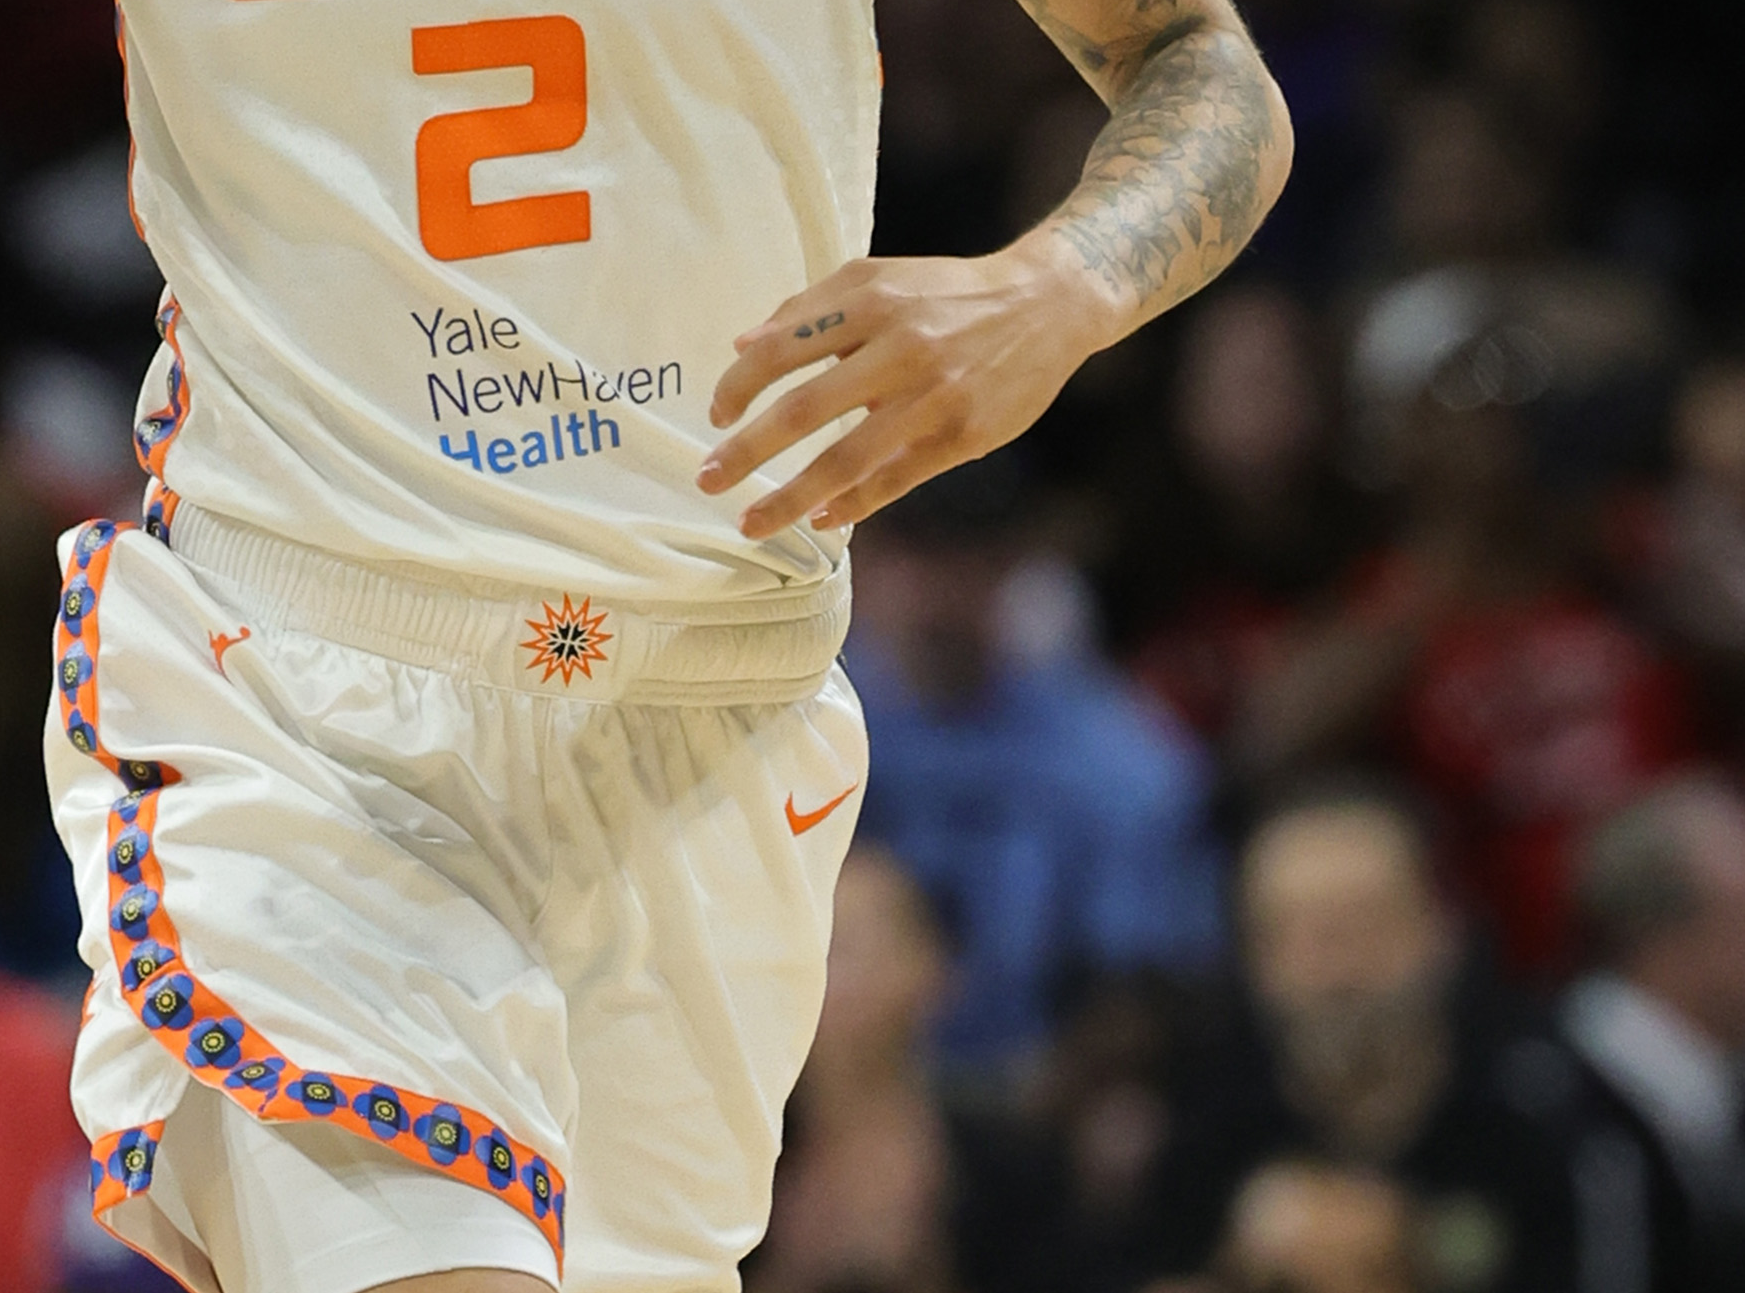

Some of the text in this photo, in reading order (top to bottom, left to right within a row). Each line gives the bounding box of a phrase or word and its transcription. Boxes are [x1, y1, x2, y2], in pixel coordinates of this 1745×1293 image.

[411, 14, 591, 262] 2
[410, 307, 520, 358] Yale
[439, 408, 621, 474] Health
